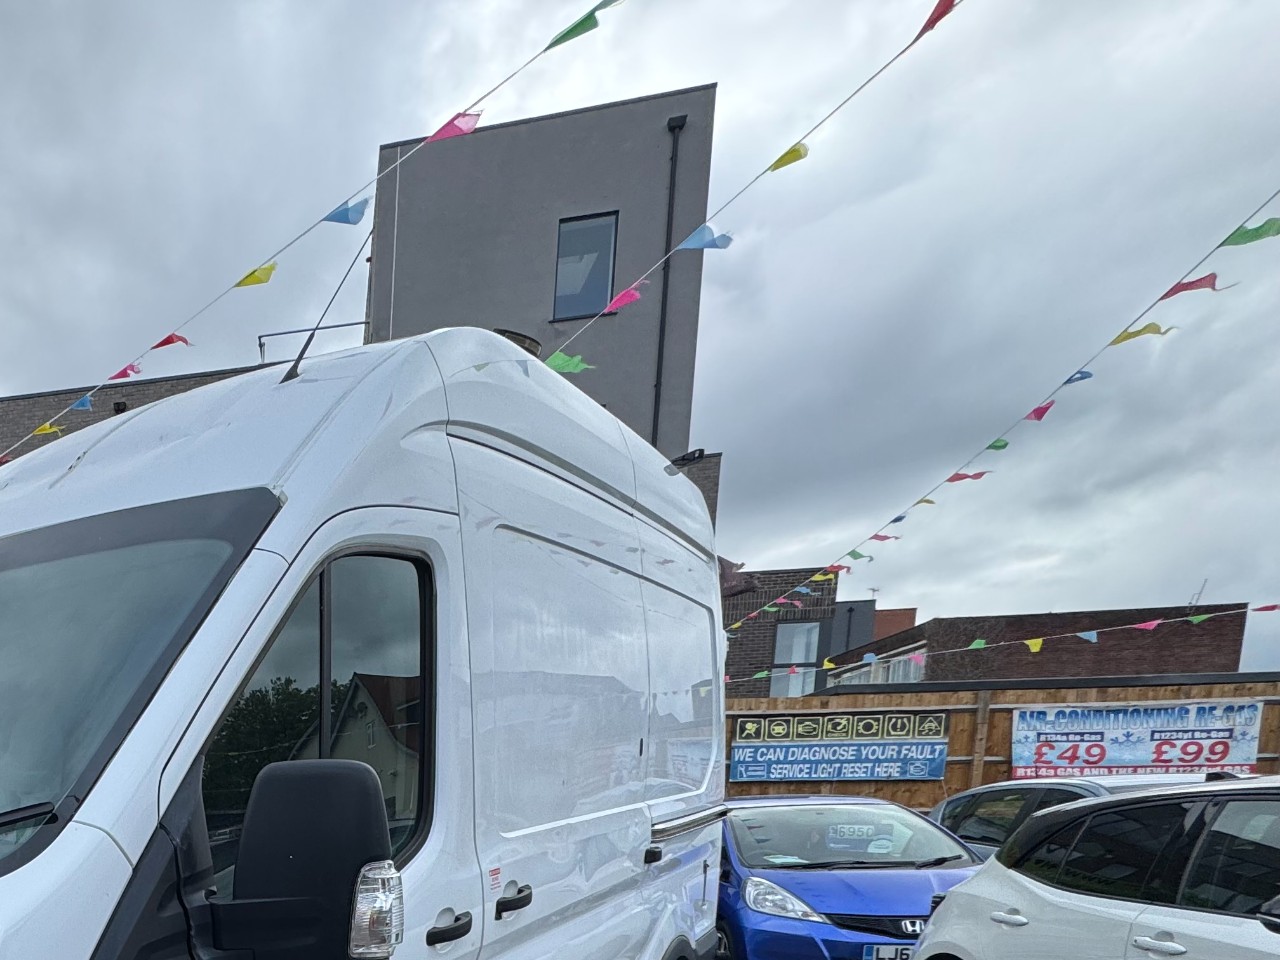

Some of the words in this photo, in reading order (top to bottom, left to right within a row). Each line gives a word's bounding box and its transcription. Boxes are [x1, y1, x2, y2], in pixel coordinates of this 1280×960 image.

[1017, 707, 1190, 731] AIR-CONDITIONING
[1194, 704, 1259, 728] RE-GAS
[734, 748, 755, 762] WE
[756, 747, 786, 761] CAN
[787, 746, 859, 761] DIAGNOSE
[860, 745, 898, 760] YOUR
[899, 744, 946, 759] FAULT
[1033, 742, 1107, 766] £49
[1151, 741, 1230, 764] £99
[770, 764, 810, 778] SERVICE
[811, 763, 840, 778] LIGHT
[841, 763, 872, 777] RESET
[876, 762, 902, 777] HERE
[1056, 767, 1081, 777] GAS
[1082, 767, 1108, 776] AND
[876, 947, 910, 960] LJ6
